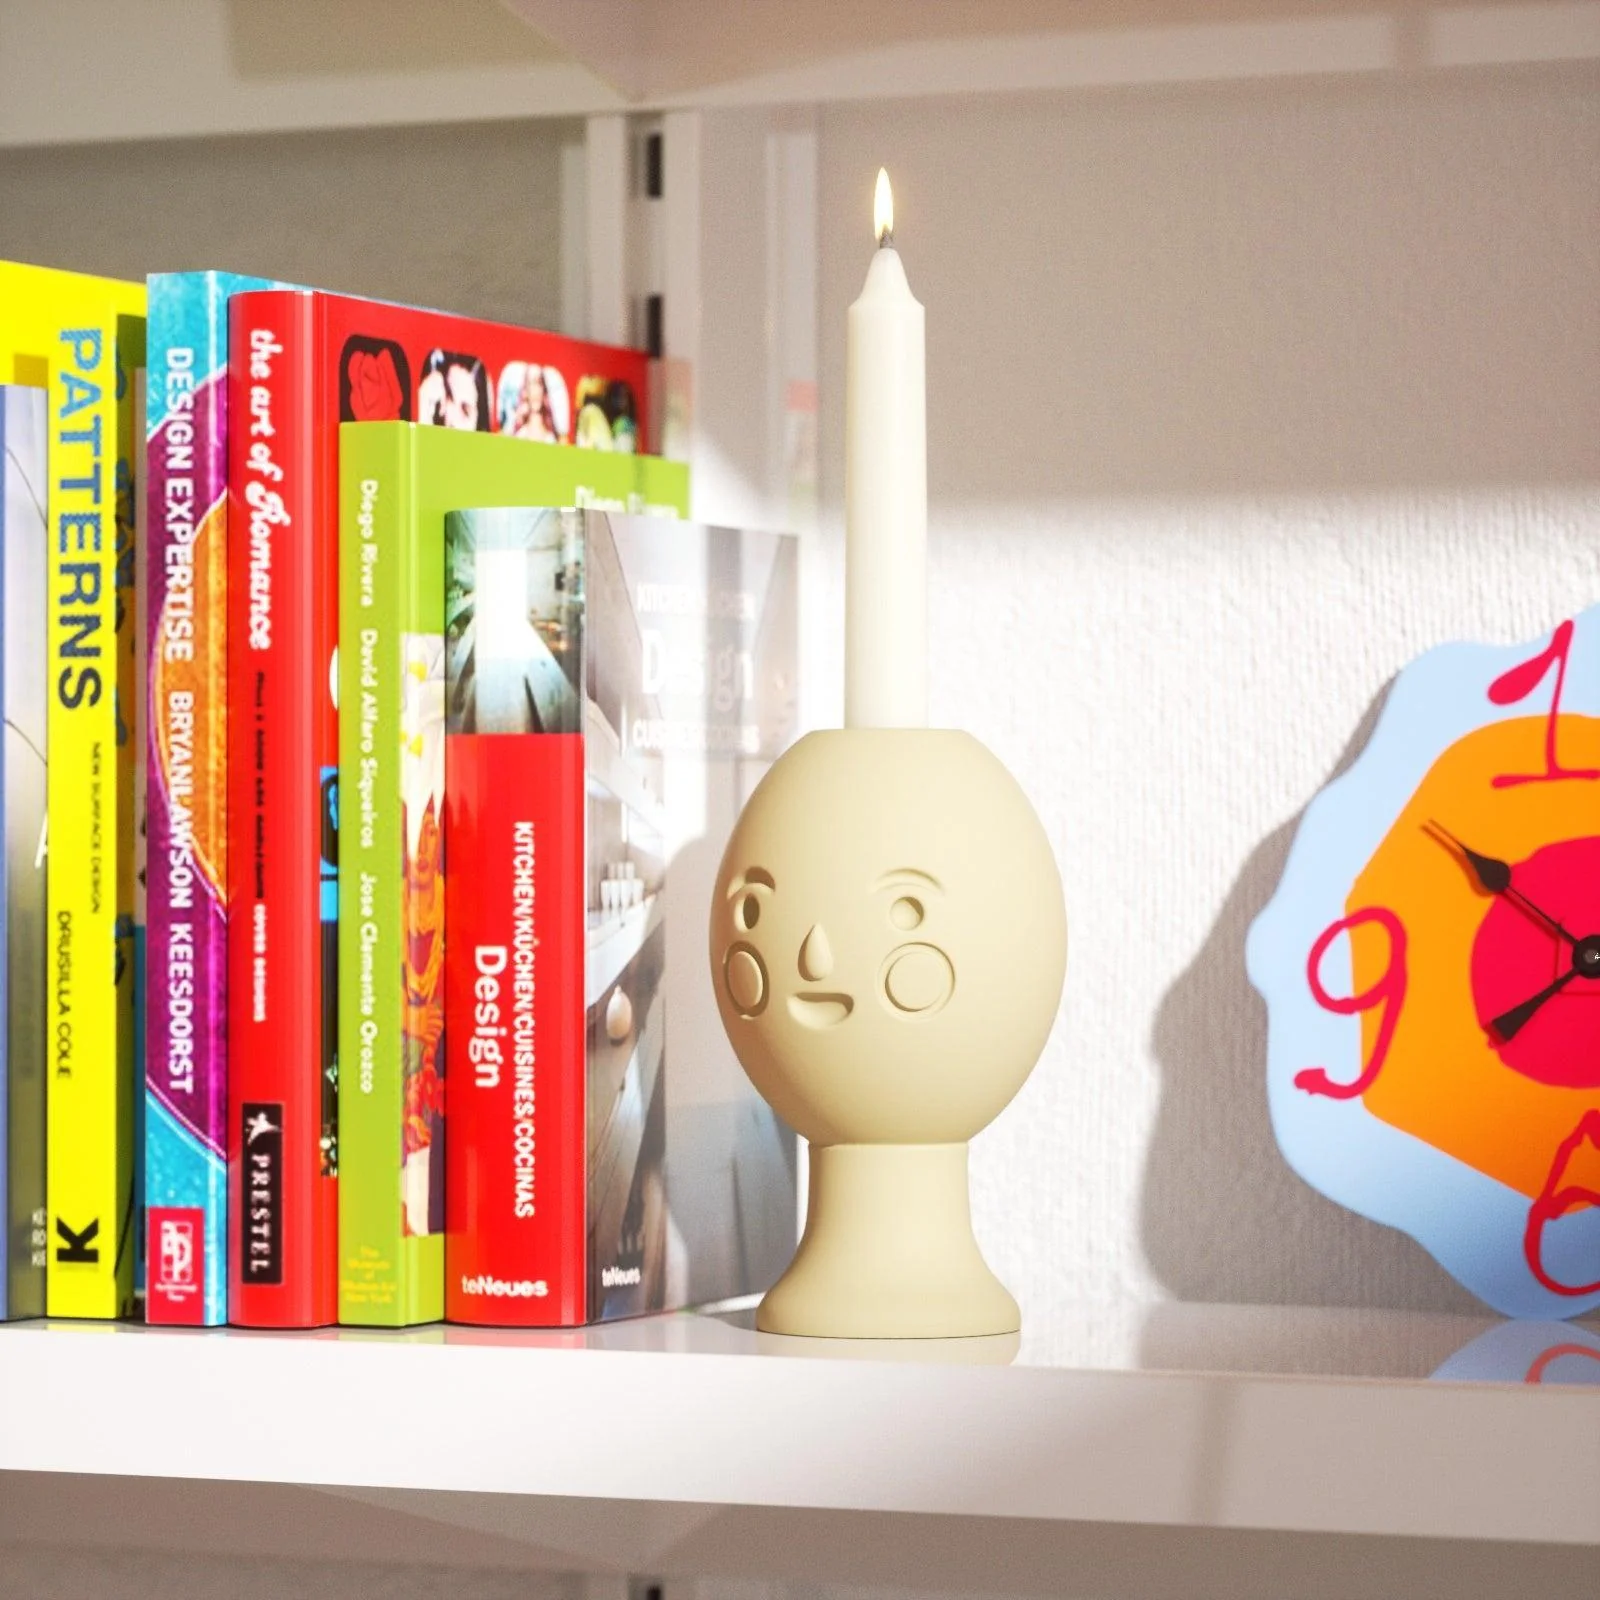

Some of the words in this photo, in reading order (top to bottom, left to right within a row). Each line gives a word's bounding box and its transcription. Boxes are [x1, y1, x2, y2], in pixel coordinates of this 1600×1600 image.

[250, 329, 284, 379] the
[165, 346, 195, 470] DESIGN
[250, 386, 276, 437] art
[246, 442, 284, 481] of
[59, 328, 103, 710] PATTERNS
[357, 478, 378, 539] Diego
[165, 477, 195, 662] EXPERTISE
[245, 481, 292, 651] Romance
[360, 543, 379, 607] Rivera
[360, 628, 379, 687] David
[57, 910, 72, 1016] DRUSILLA
[468, 945, 508, 1088] Design
[1293, 905, 1408, 1100] 9
[57, 1021, 72, 1080] COLE
[359, 1020, 379, 1094] Orozco
[250, 1153, 272, 1274] PRESTEL
[461, 1275, 549, 1298] teNeues
